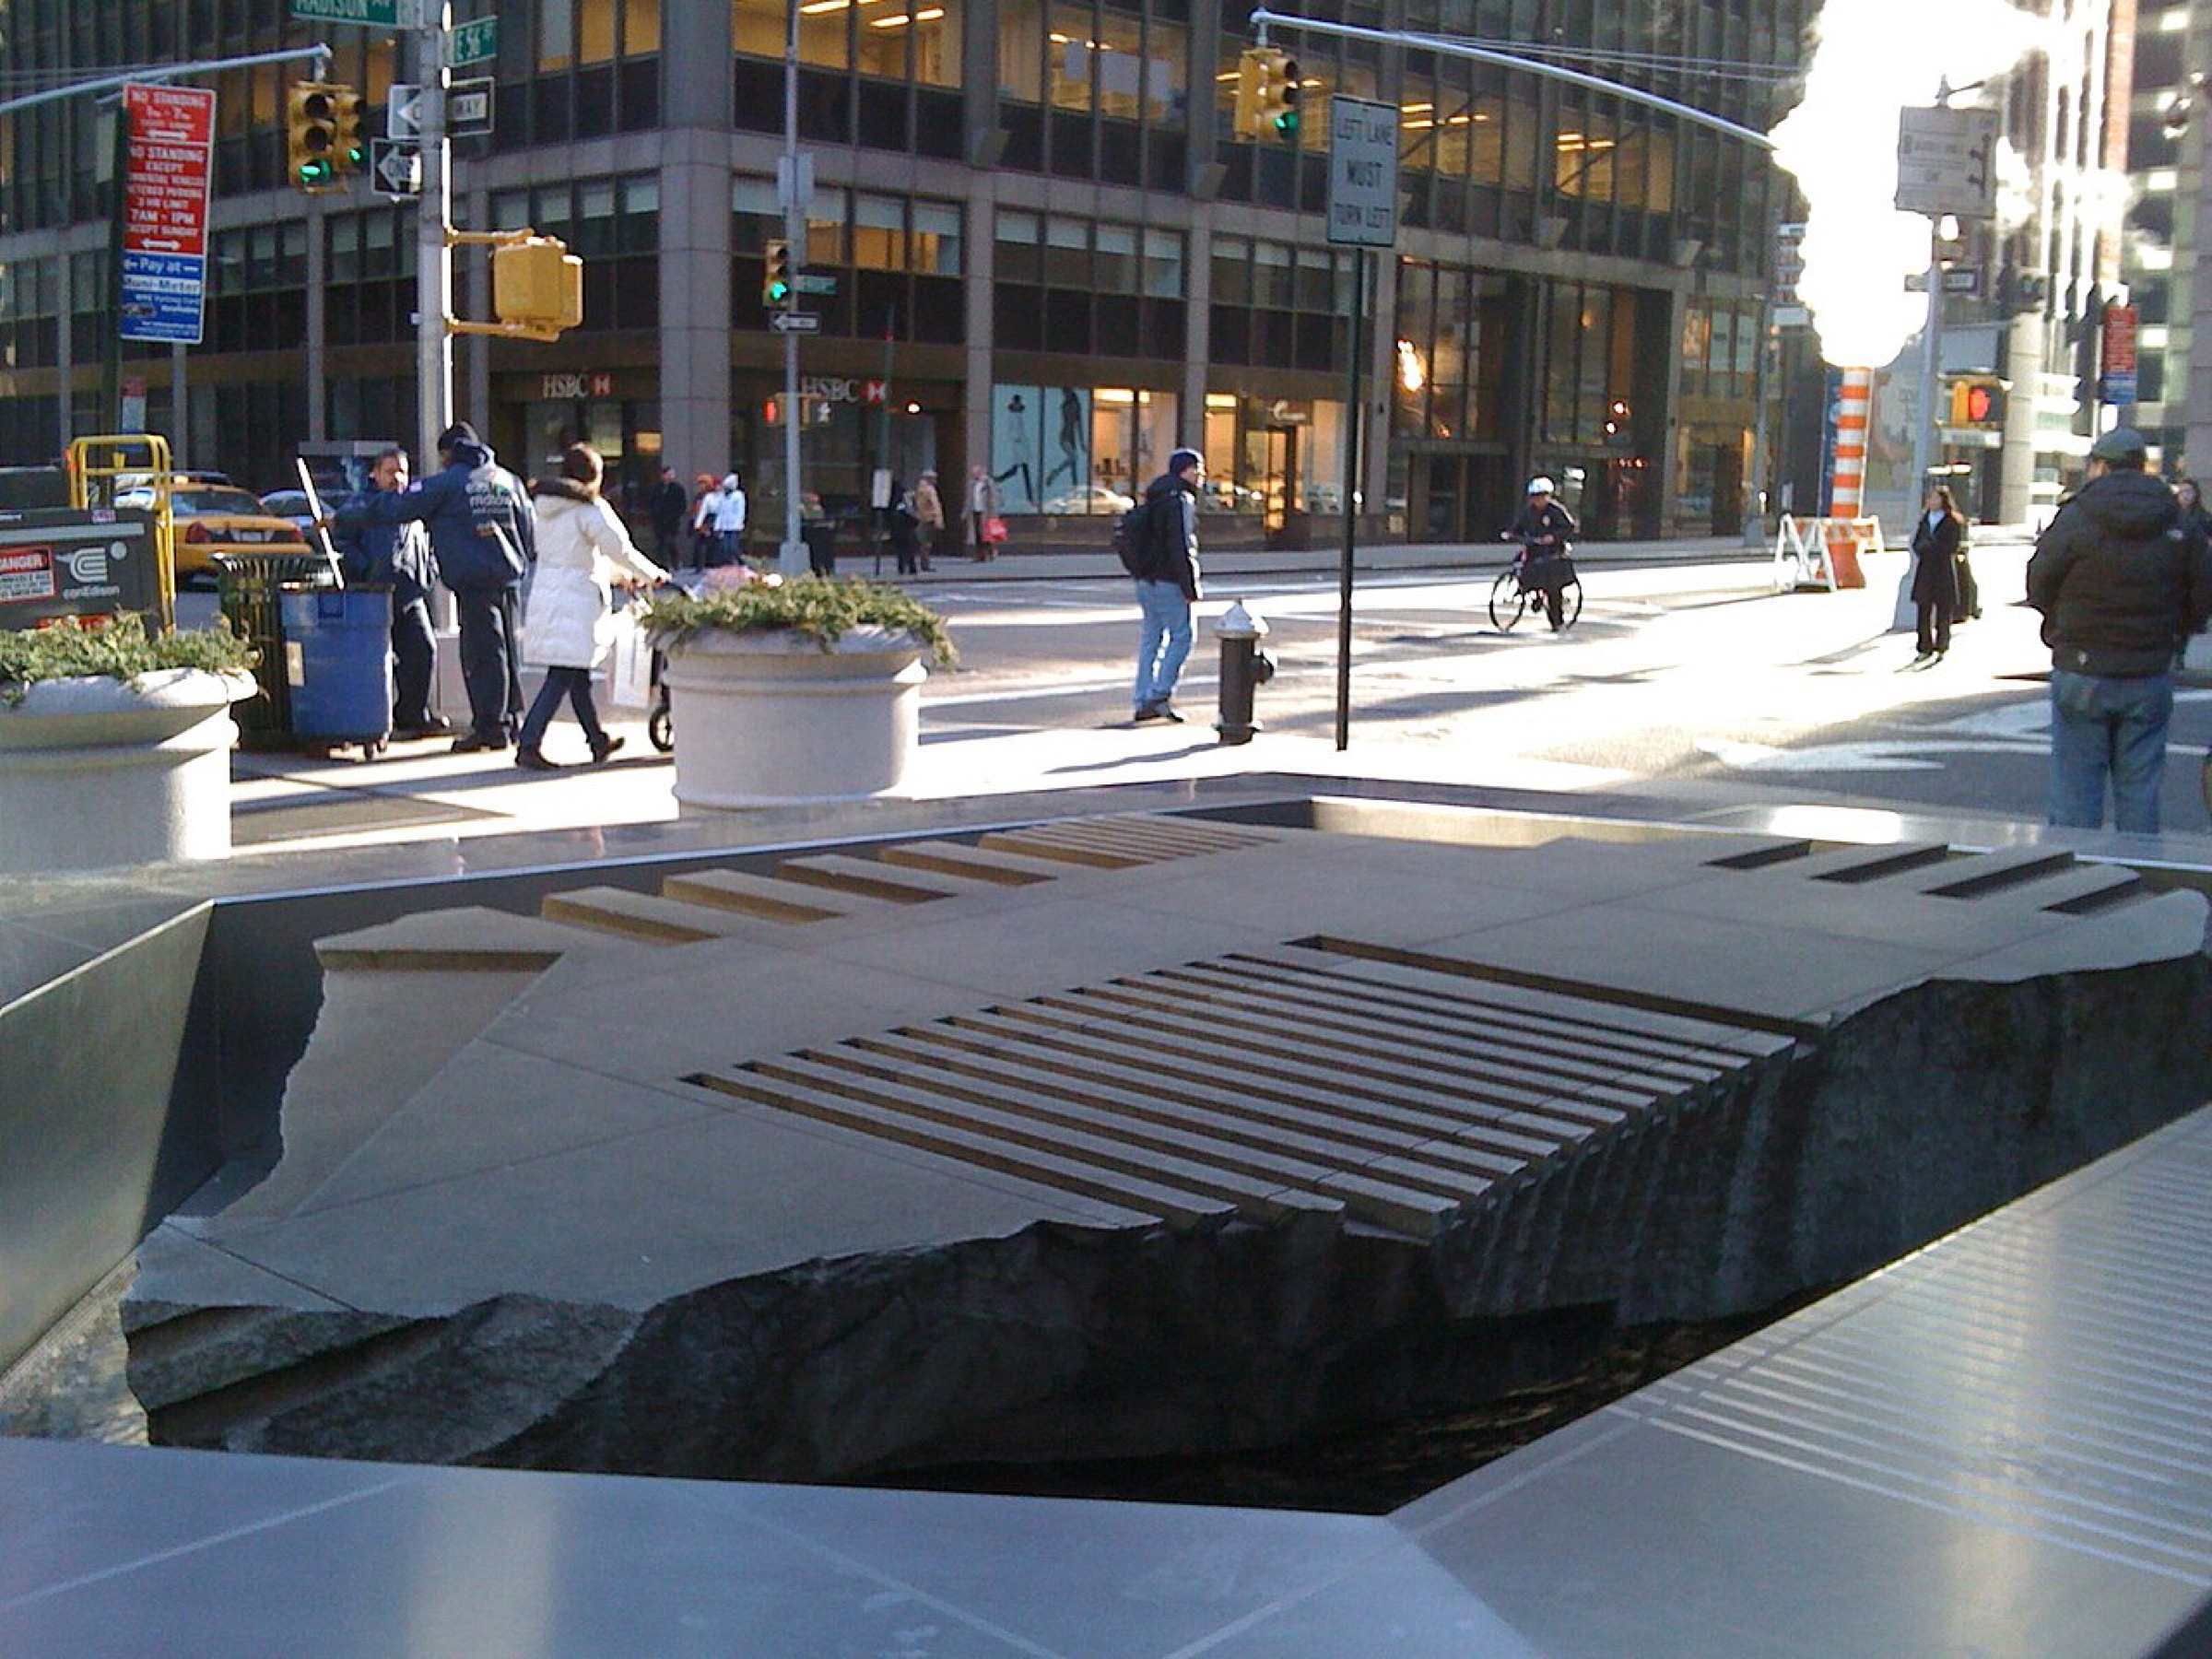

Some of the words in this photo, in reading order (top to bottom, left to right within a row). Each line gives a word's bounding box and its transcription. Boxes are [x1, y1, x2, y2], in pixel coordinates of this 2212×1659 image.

[153, 93, 206, 107] STANDING
[147, 147, 205, 162] STANDING
[140, 257, 165, 275] Pay
[168, 262, 182, 273] at
[542, 374, 589, 399] HSBC
[801, 376, 859, 403] HSBC
